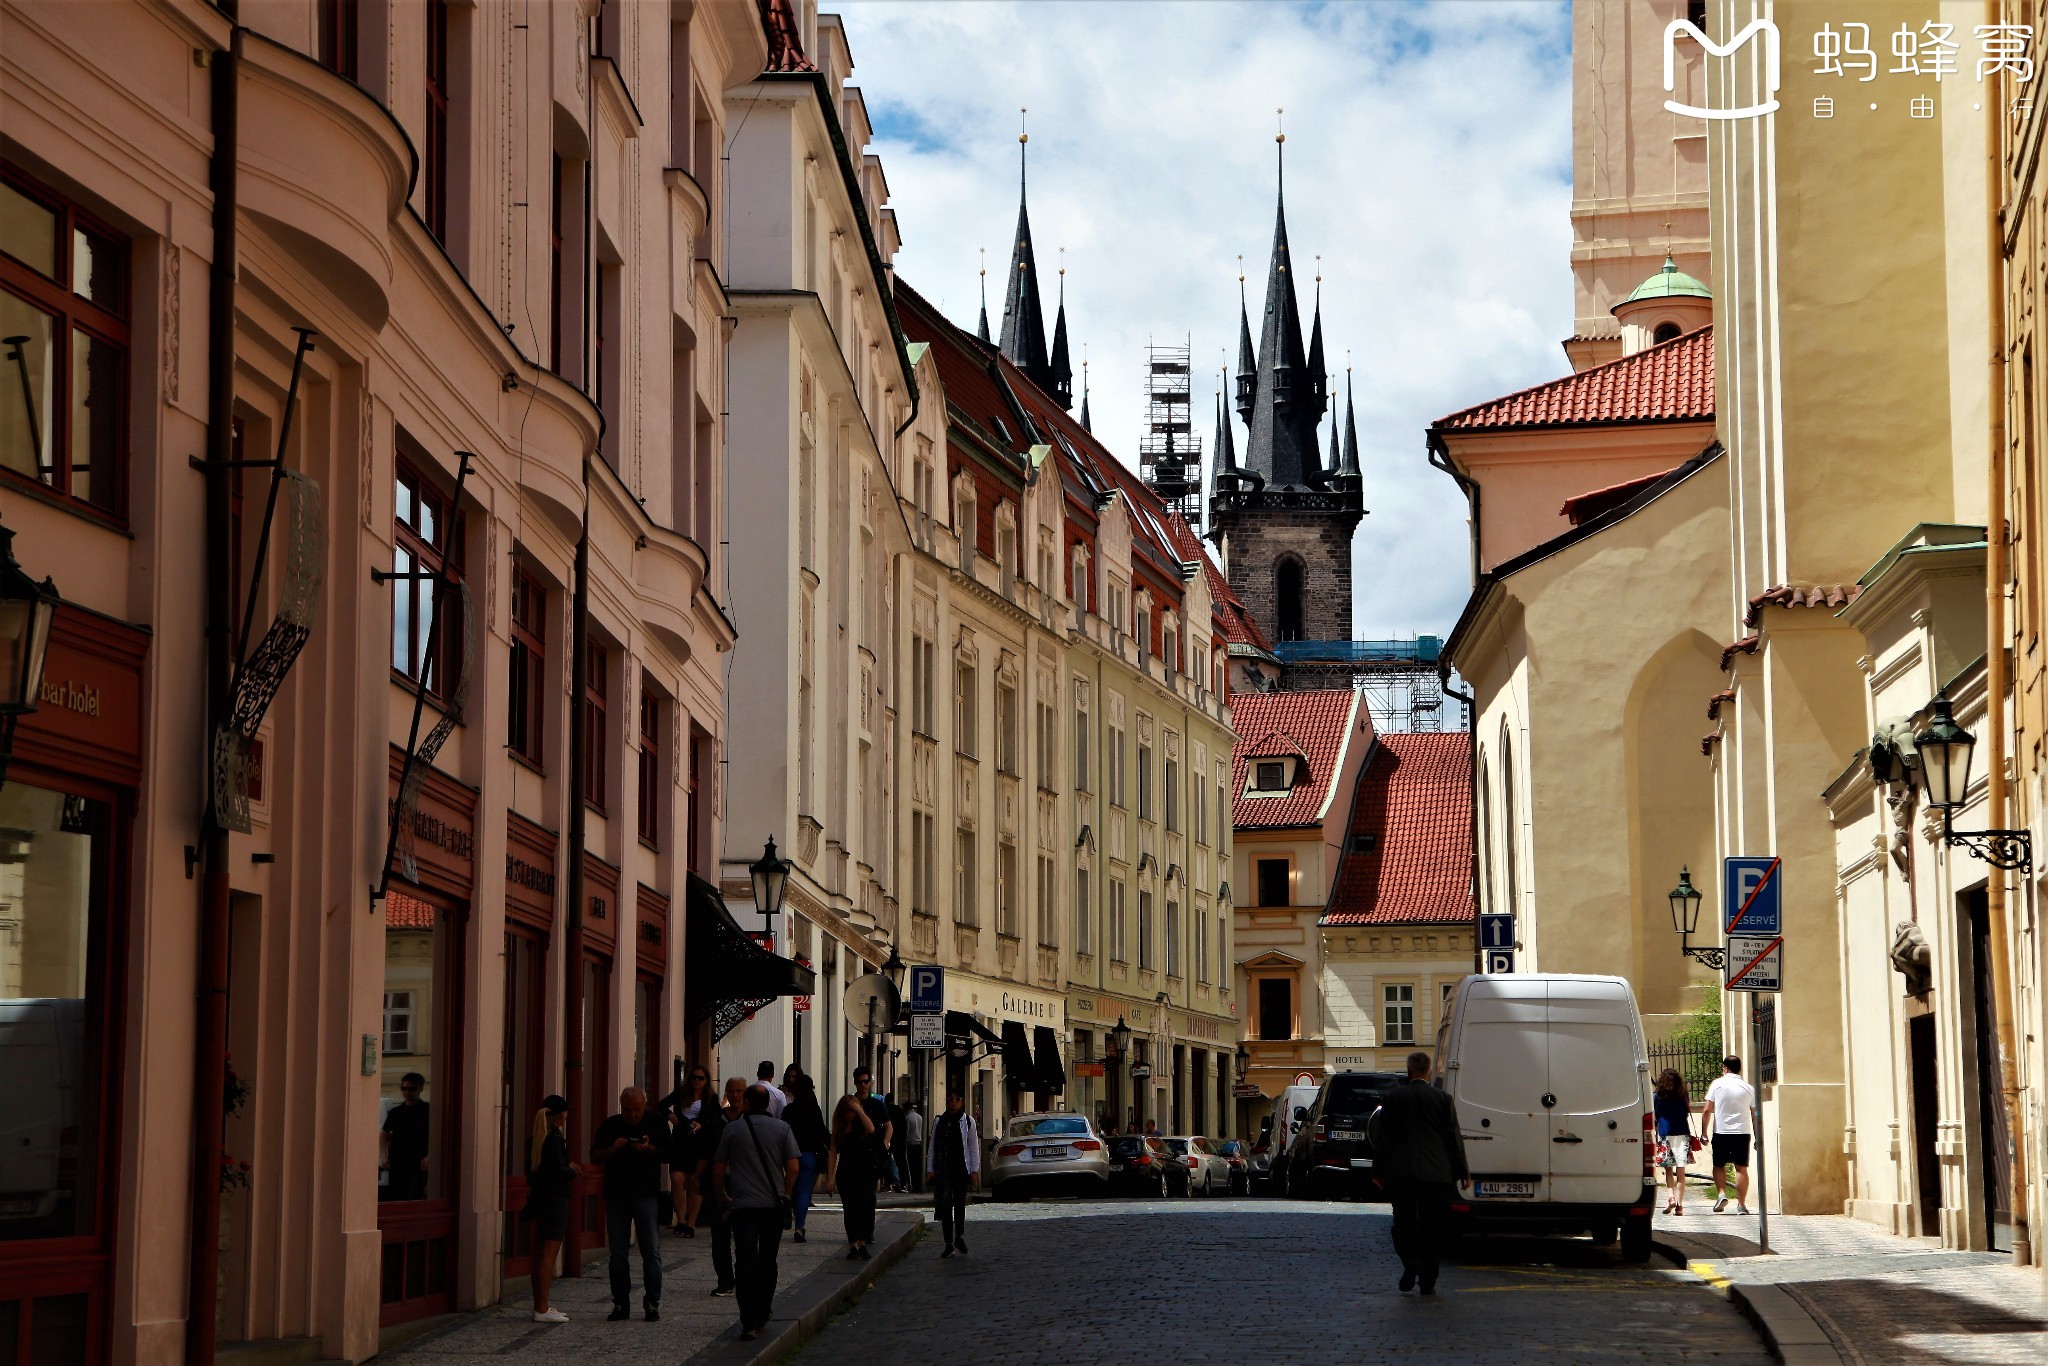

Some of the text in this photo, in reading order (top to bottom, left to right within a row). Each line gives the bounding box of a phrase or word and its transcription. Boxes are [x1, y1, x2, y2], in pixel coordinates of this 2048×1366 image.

[68, 679, 100, 718] hotel
[917, 971, 937, 998] P
[1002, 992, 1044, 1018] GALERIE
[1335, 1056, 1364, 1064] HOTEL
[1483, 1183, 1529, 1193] 4AU 2961
